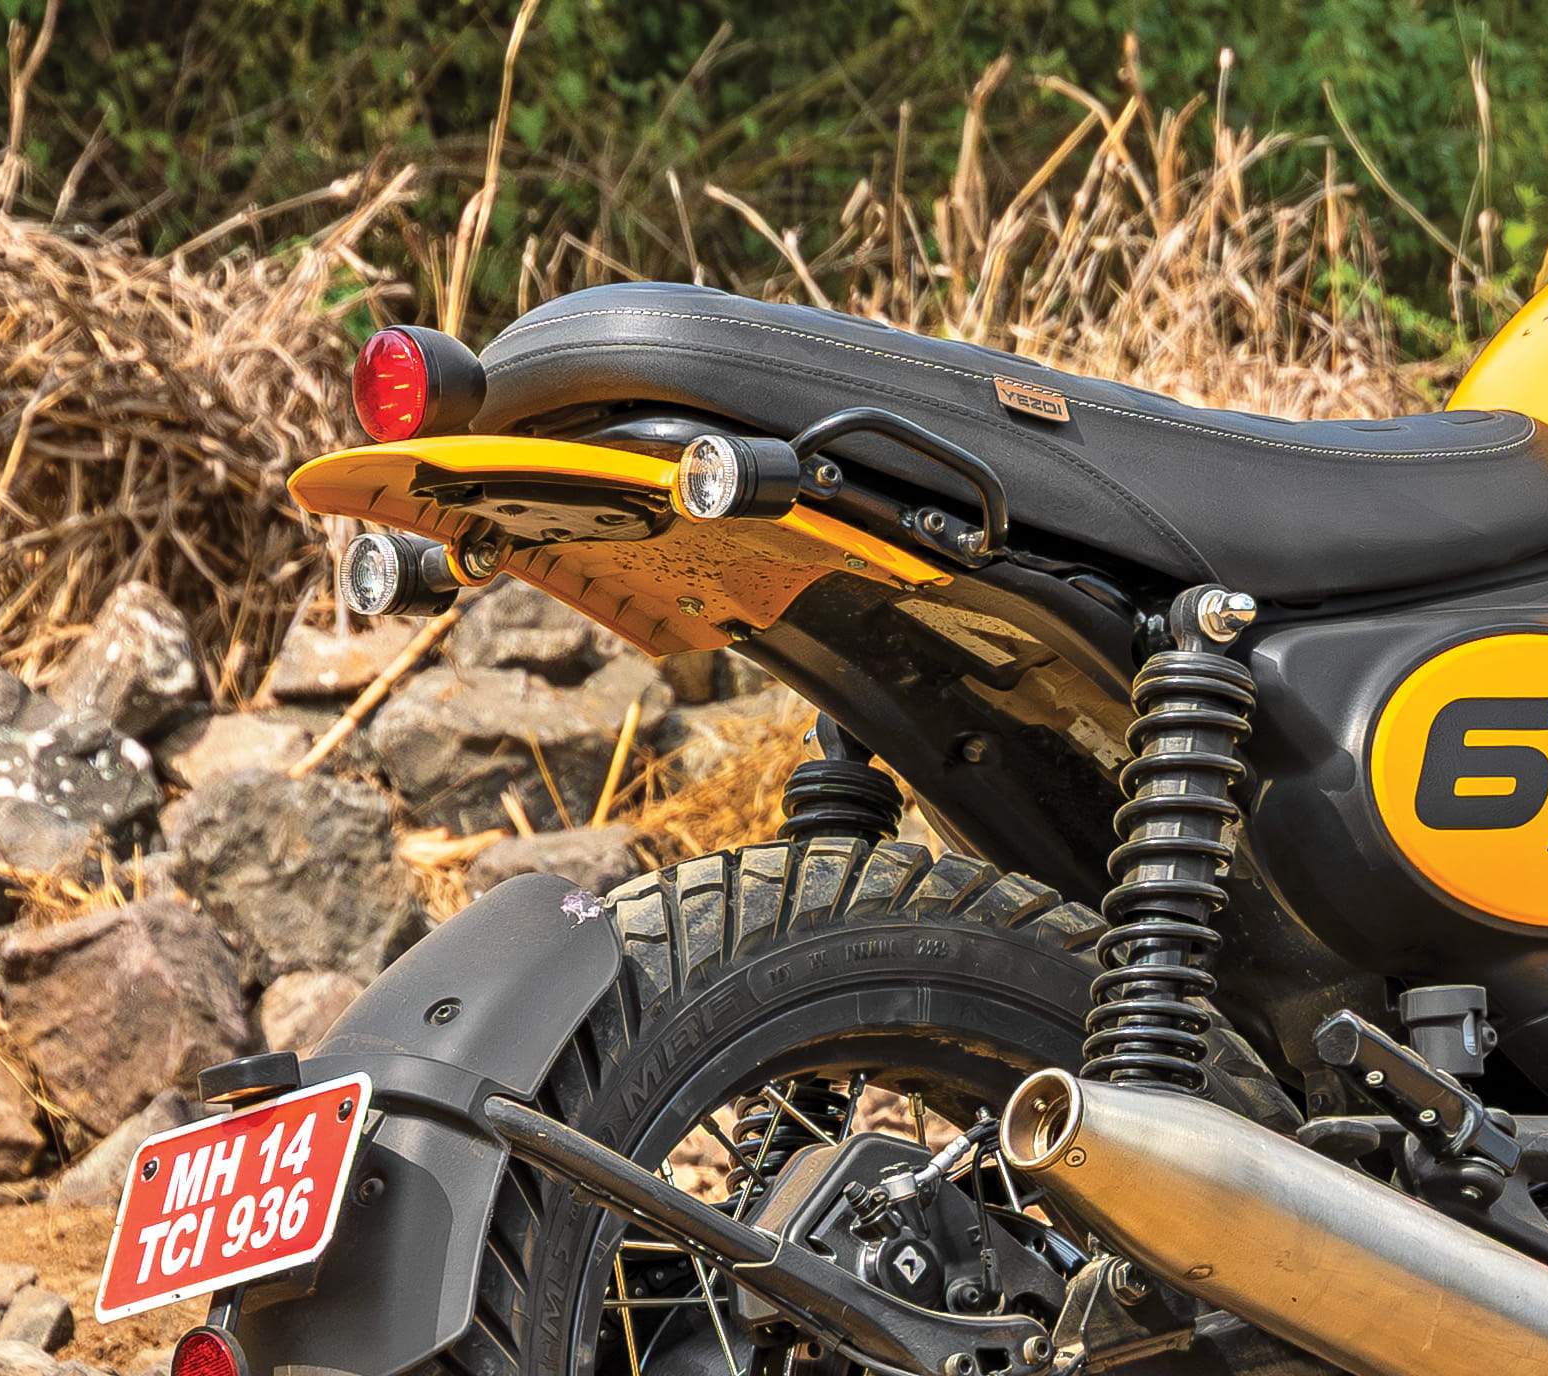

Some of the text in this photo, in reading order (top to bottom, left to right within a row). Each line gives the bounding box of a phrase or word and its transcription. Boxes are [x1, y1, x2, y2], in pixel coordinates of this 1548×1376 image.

[1001, 389, 1063, 416] YEZDI
[162, 1112, 317, 1215] MH 14
[136, 1176, 316, 1286] TCI 936
